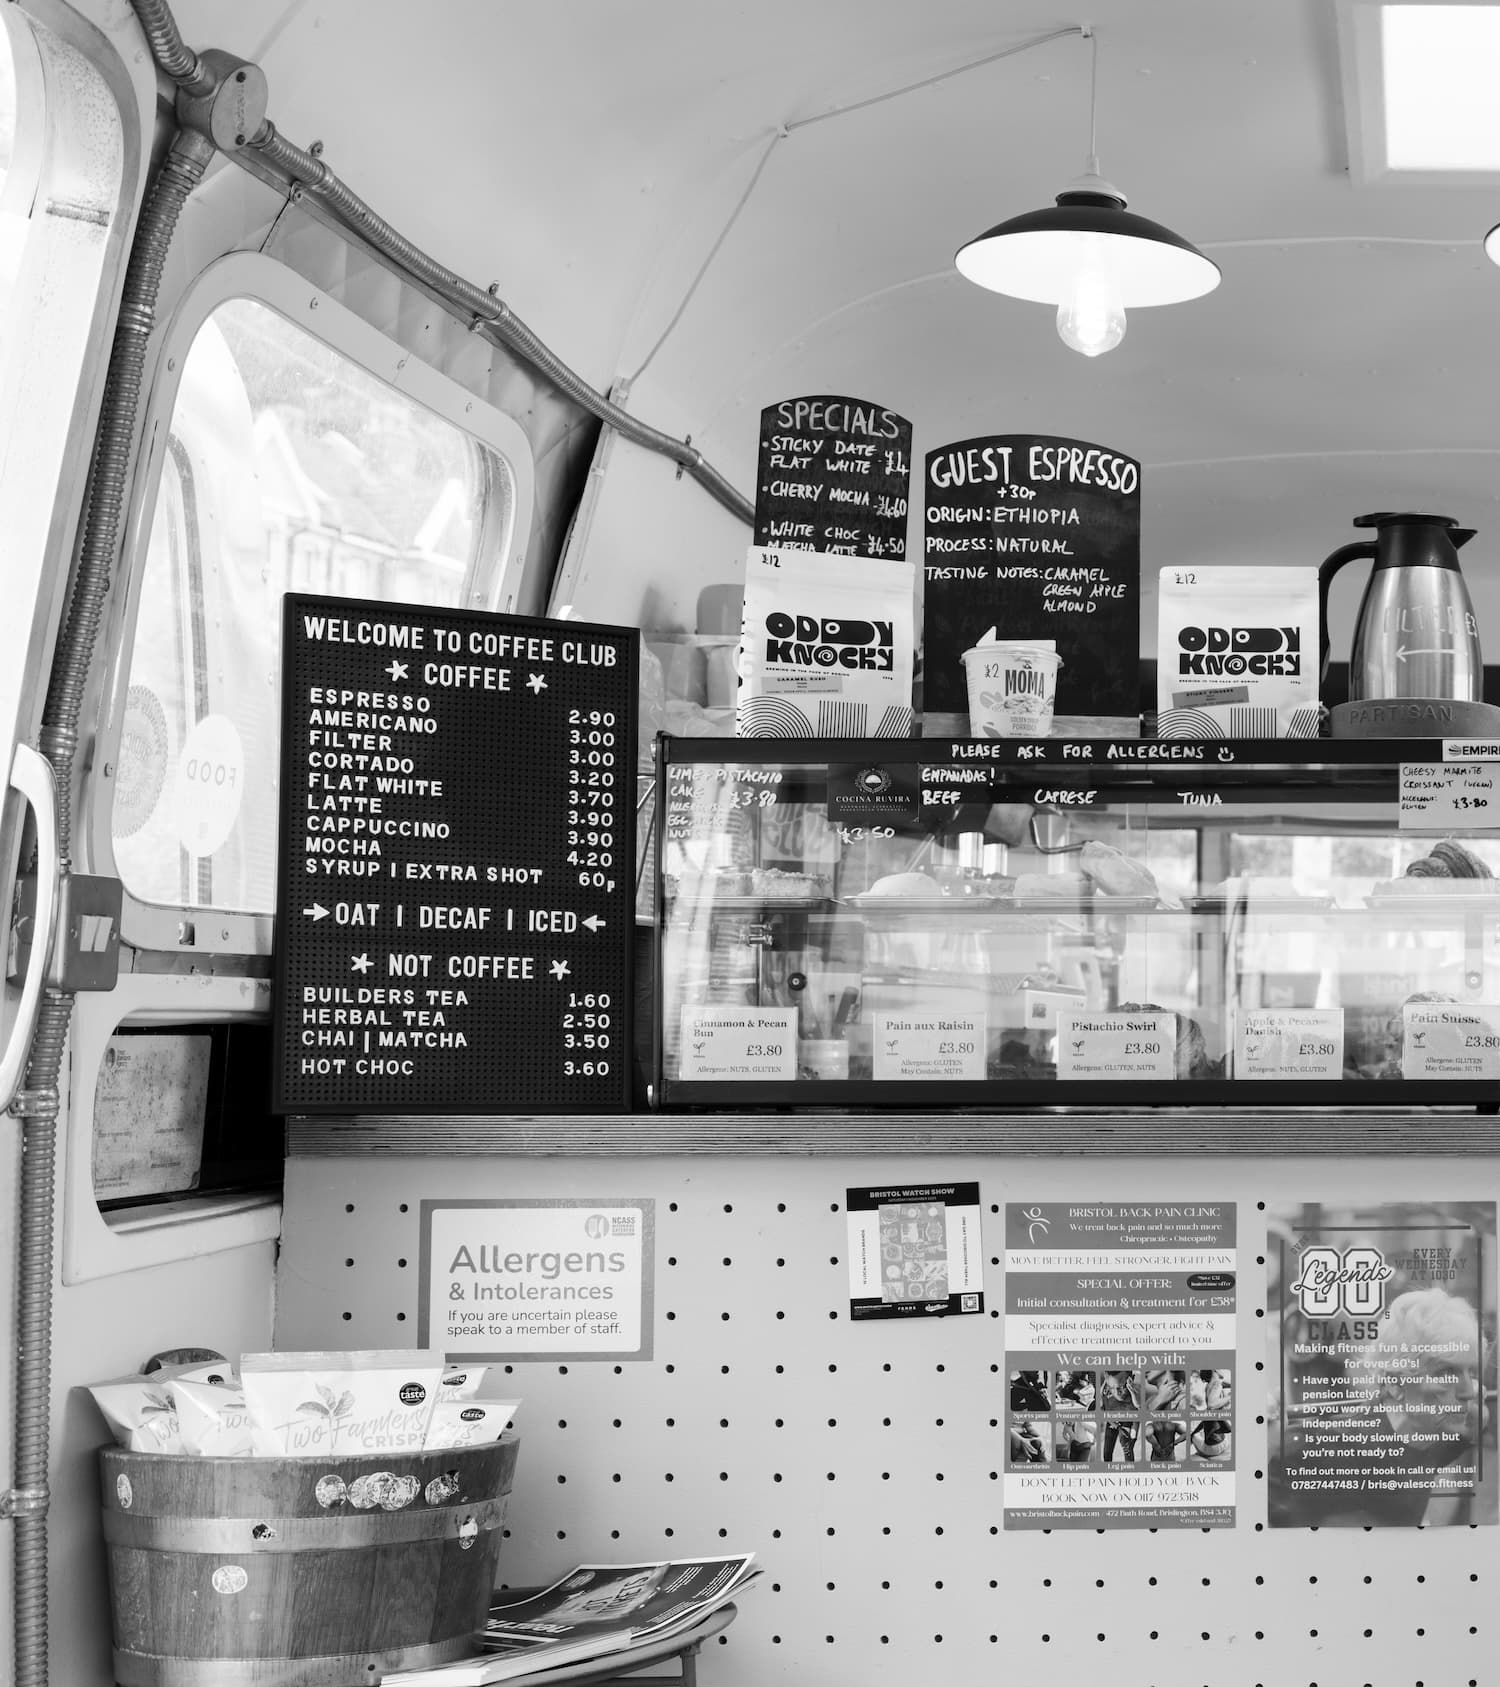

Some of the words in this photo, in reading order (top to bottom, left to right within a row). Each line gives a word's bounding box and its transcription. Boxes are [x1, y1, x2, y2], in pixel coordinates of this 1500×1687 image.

[778, 401, 899, 438] SPECIALS
[771, 436, 824, 454] STICKY
[835, 441, 877, 456] DATE
[770, 455, 812, 469] FLAT
[826, 459, 871, 474] WHITE
[931, 447, 1012, 487] GUEST
[1029, 446, 1137, 494] ESPRESSO
[770, 480, 823, 501] CHERRY
[829, 488, 869, 506] MOCHA
[770, 521, 814, 536] WHITE
[825, 528, 860, 540] CHOC
[924, 567, 988, 580] TASTING
[1175, 573, 1197, 584] £12
[1043, 584, 1082, 597] GREEN
[1090, 584, 1126, 598] APPLE
[1043, 600, 1096, 613] ALMOND
[304, 616, 424, 649] WELCOME
[434, 630, 461, 652] TO
[469, 632, 554, 661] COFFEE
[562, 642, 616, 667] CLUB
[766, 639, 893, 671] KNOCKY
[1179, 654, 1300, 675] KNOCKY
[425, 663, 511, 691] COFFEE
[1005, 670, 1044, 699] MOMA
[310, 688, 430, 712] ESPRESSO
[569, 710, 615, 727] 2.90
[309, 710, 437, 733] AMERICANO
[569, 730, 615, 746] 3.00
[310, 731, 392, 751] FILTER
[569, 751, 615, 767] 3.00
[952, 744, 1000, 758] PLEASE
[1017, 746, 1046, 758] ASK
[1062, 744, 1092, 758] FOR
[1107, 744, 1204, 759] ALLERGENS
[309, 752, 414, 773] CORTADO
[569, 771, 614, 786] 3.20
[1403, 767, 1436, 776] CHEESY
[1444, 767, 1482, 775] MARMITE
[309, 773, 368, 791] FLAT
[376, 777, 443, 796] WHITE
[569, 790, 614, 807] 3.70
[1404, 781, 1453, 789] CROISSANT
[922, 791, 960, 804] BEEF
[1034, 789, 1097, 804] CAPRESE
[1177, 792, 1222, 806] TUNA
[307, 795, 382, 814] LATTE
[568, 811, 614, 827] 3.90
[307, 816, 450, 839] CAPPUCCINO
[568, 831, 613, 847] 3.90
[306, 837, 382, 856] MOCHA
[567, 851, 612, 867] 4.20
[306, 859, 380, 876] SYRUP
[406, 864, 477, 881] EXTRA
[487, 867, 543, 884] SHOT
[579, 873, 615, 892] 60p
[335, 903, 380, 926] OAT
[420, 906, 491, 929] DECAF
[529, 910, 576, 933] ICED
[389, 954, 432, 976] NOT
[449, 956, 534, 979] COFFEE
[304, 987, 415, 1004] BUILDERS
[426, 990, 468, 1006] TEA
[569, 994, 610, 1008] 1.60
[303, 1009, 392, 1025] HERBAL
[403, 1011, 446, 1026] TEA
[563, 1014, 610, 1029] 2.50
[758, 1019, 787, 1028] Pecan
[886, 1021, 911, 1030] Pain
[938, 1021, 974, 1030] Raisin
[1072, 1022, 1123, 1031] Pistachio
[1126, 1022, 1156, 1031] Swirl
[1441, 1013, 1480, 1024] Suisse
[302, 1030, 354, 1045] CHAI
[379, 1032, 467, 1048] MATCHA
[564, 1034, 609, 1049] 3.50
[938, 1042, 974, 1054] £3.80
[1465, 1036, 1500, 1047] £3.80
[746, 1045, 782, 1056] £3.80
[1124, 1043, 1160, 1054] £3.80
[1299, 1044, 1334, 1056] £3.80
[302, 1059, 346, 1074] HOT
[356, 1059, 414, 1074] CHOC
[564, 1061, 609, 1075] 3.60
[612, 1216, 635, 1224] NCASS
[1069, 1208, 1117, 1217] BRISTOL
[1120, 1208, 1151, 1217] BACK
[1155, 1208, 1182, 1217] PAIN
[1184, 1208, 1221, 1216] CLINIC
[1413, 1248, 1451, 1258] EVERY
[449, 1245, 624, 1279] Allergens
[1395, 1258, 1466, 1269] WEDNESDAY
[1077, 1279, 1125, 1289] SPECIAL
[1130, 1279, 1172, 1288] OFFER:
[1293, 1259, 1392, 1294] Legends
[449, 1282, 464, 1300] &
[474, 1282, 613, 1300] Intolerances
[448, 1310, 459, 1321] If
[461, 1313, 483, 1323] you
[488, 1312, 508, 1320] are
[512, 1310, 571, 1321] uncertain
[575, 1309, 617, 1324] please
[448, 1324, 485, 1337] speak
[489, 1325, 501, 1334] to
[517, 1324, 569, 1334] member
[574, 1323, 586, 1334] of
[590, 1323, 622, 1334] staff.
[1308, 1322, 1378, 1340] CLASS
[1057, 1354, 1081, 1366] We
[1085, 1356, 1111, 1366] can
[1116, 1353, 1147, 1368] help
[1152, 1353, 1185, 1365] with:
[273, 1417, 327, 1454] Two
[1291, 1481, 1358, 1489] 07827447483
[1368, 1479, 1473, 1490] bris@valesco.fitness
[1042, 1494, 1076, 1503] BOOK
[1082, 1494, 1108, 1503] NOW
[1114, 1494, 1132, 1502] ON
